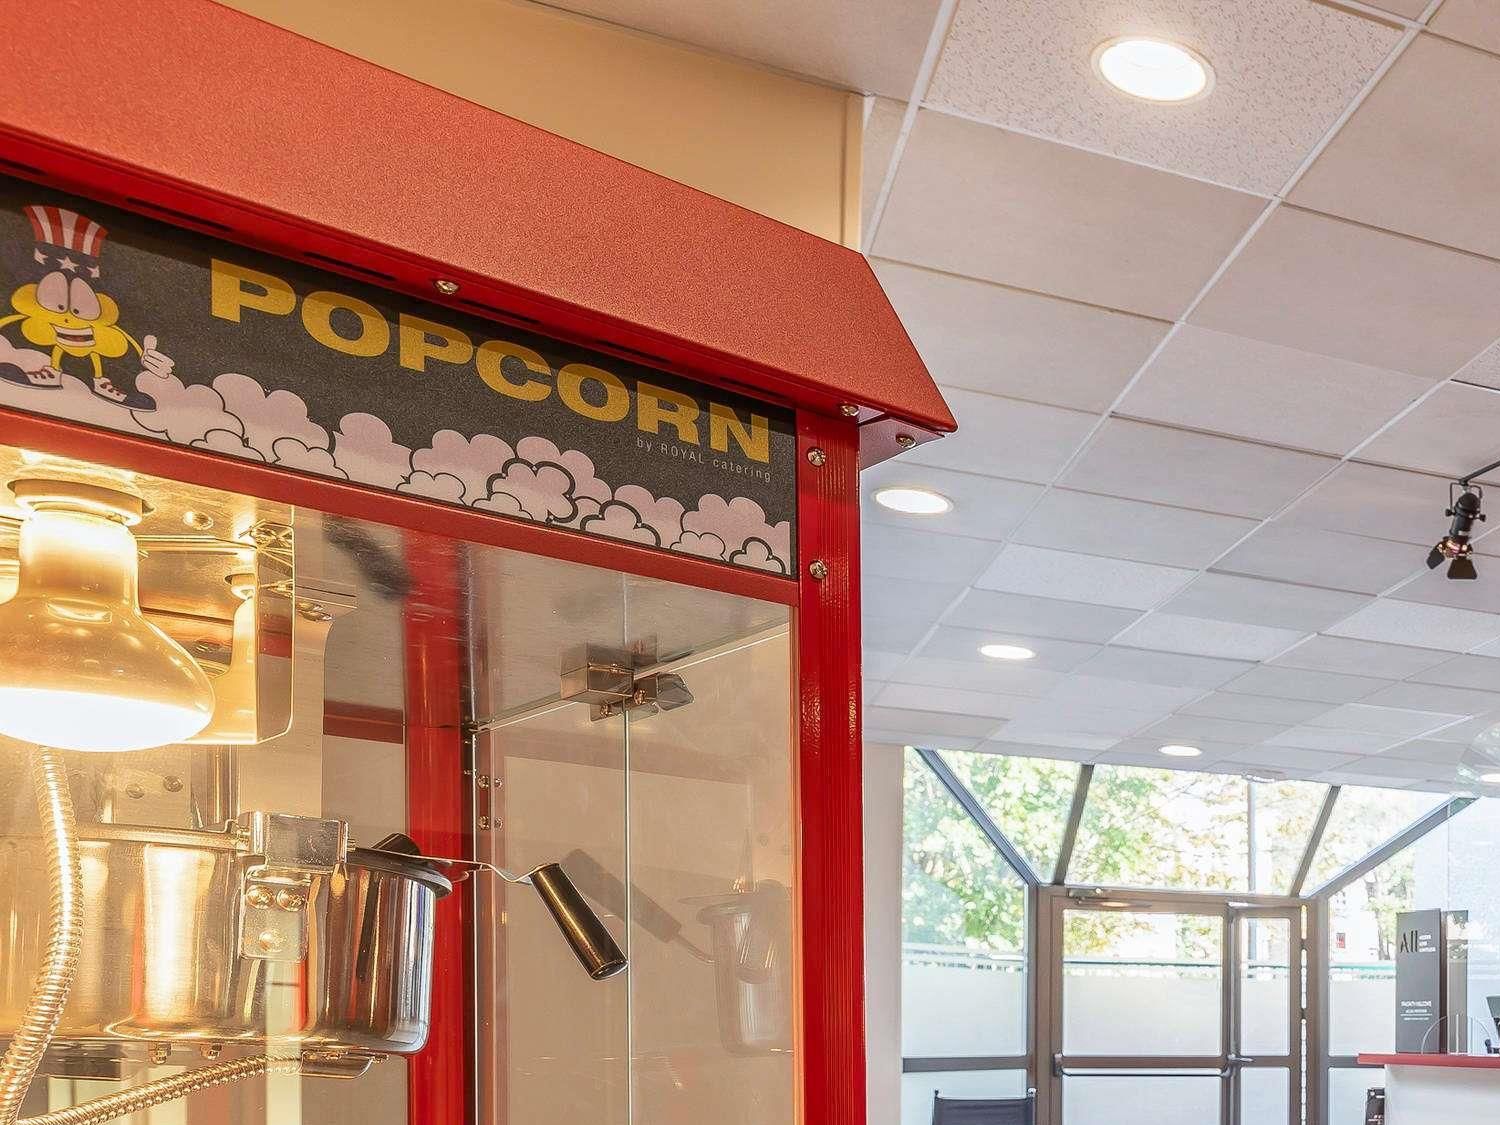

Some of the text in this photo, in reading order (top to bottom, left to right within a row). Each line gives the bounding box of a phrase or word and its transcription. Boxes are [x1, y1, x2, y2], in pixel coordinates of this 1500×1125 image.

[211, 259, 770, 463] POPCORN
[637, 436, 771, 483] by ROYAL catering
